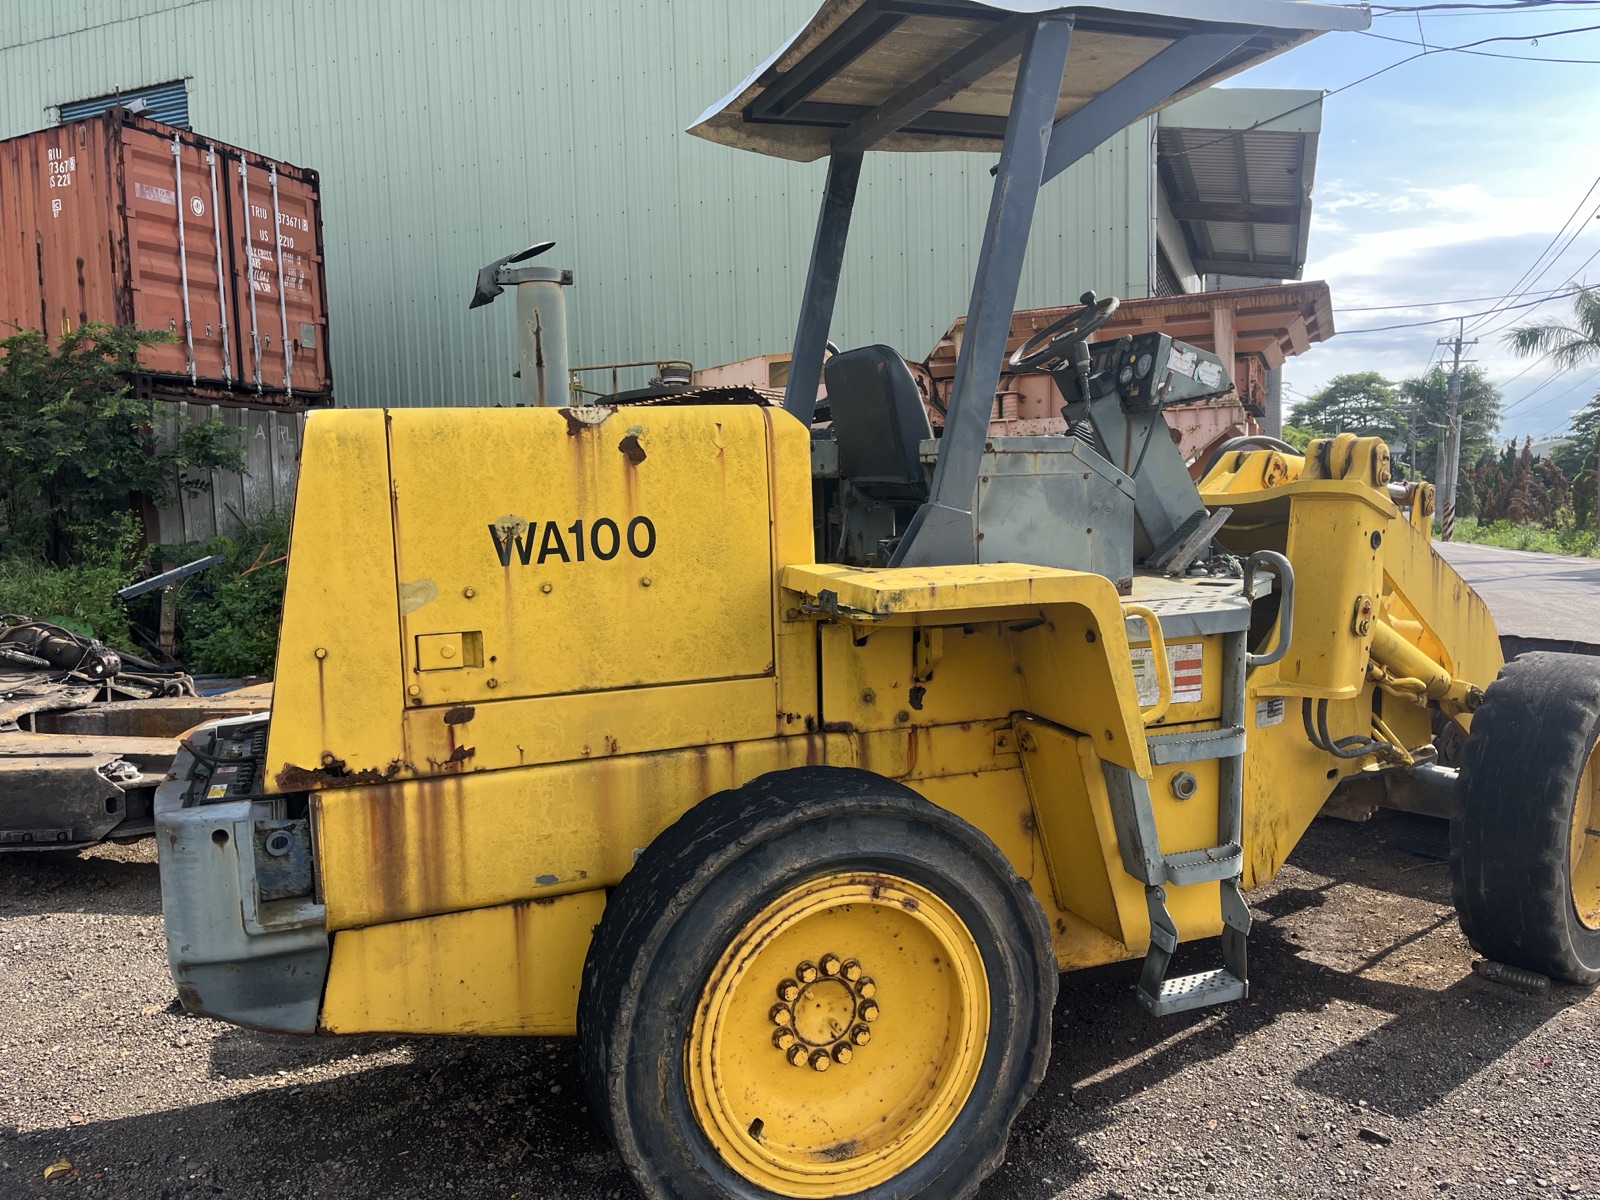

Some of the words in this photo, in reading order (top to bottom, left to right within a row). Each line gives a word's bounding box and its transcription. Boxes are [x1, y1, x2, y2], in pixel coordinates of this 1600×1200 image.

[251, 205, 267, 220] TRIU
[259, 229, 269, 241] US
[487, 515, 657, 567] WA100
